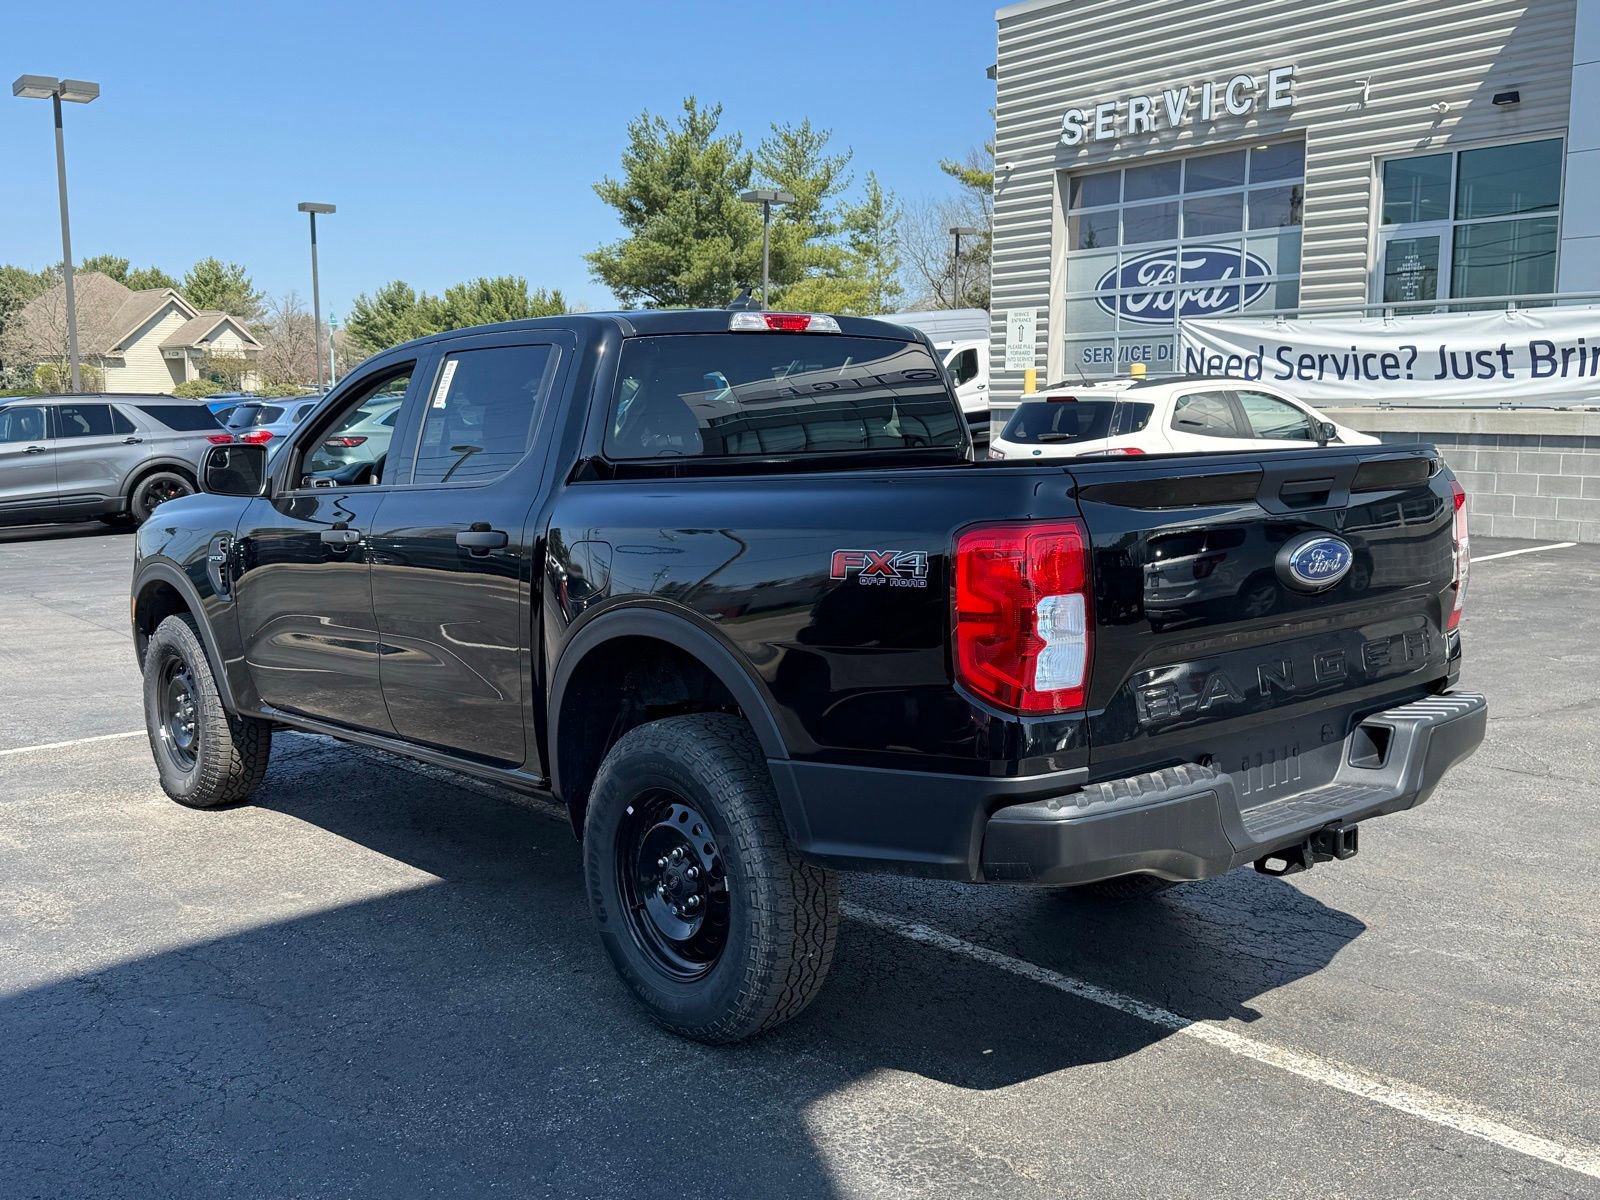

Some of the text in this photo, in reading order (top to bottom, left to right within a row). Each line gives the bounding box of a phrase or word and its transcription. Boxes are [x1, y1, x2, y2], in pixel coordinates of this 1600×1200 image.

[1061, 64, 1296, 146] SERVICE
[1126, 257, 1234, 312] Ford
[1083, 345, 1152, 364] SERVICE
[1185, 345, 1264, 381] Need
[1274, 345, 1418, 381] Service?
[1434, 343, 1515, 380] Just
[830, 549, 928, 579] FX4
[859, 577, 927, 587] OFF ROAD
[1136, 630, 1432, 723] RANGER
